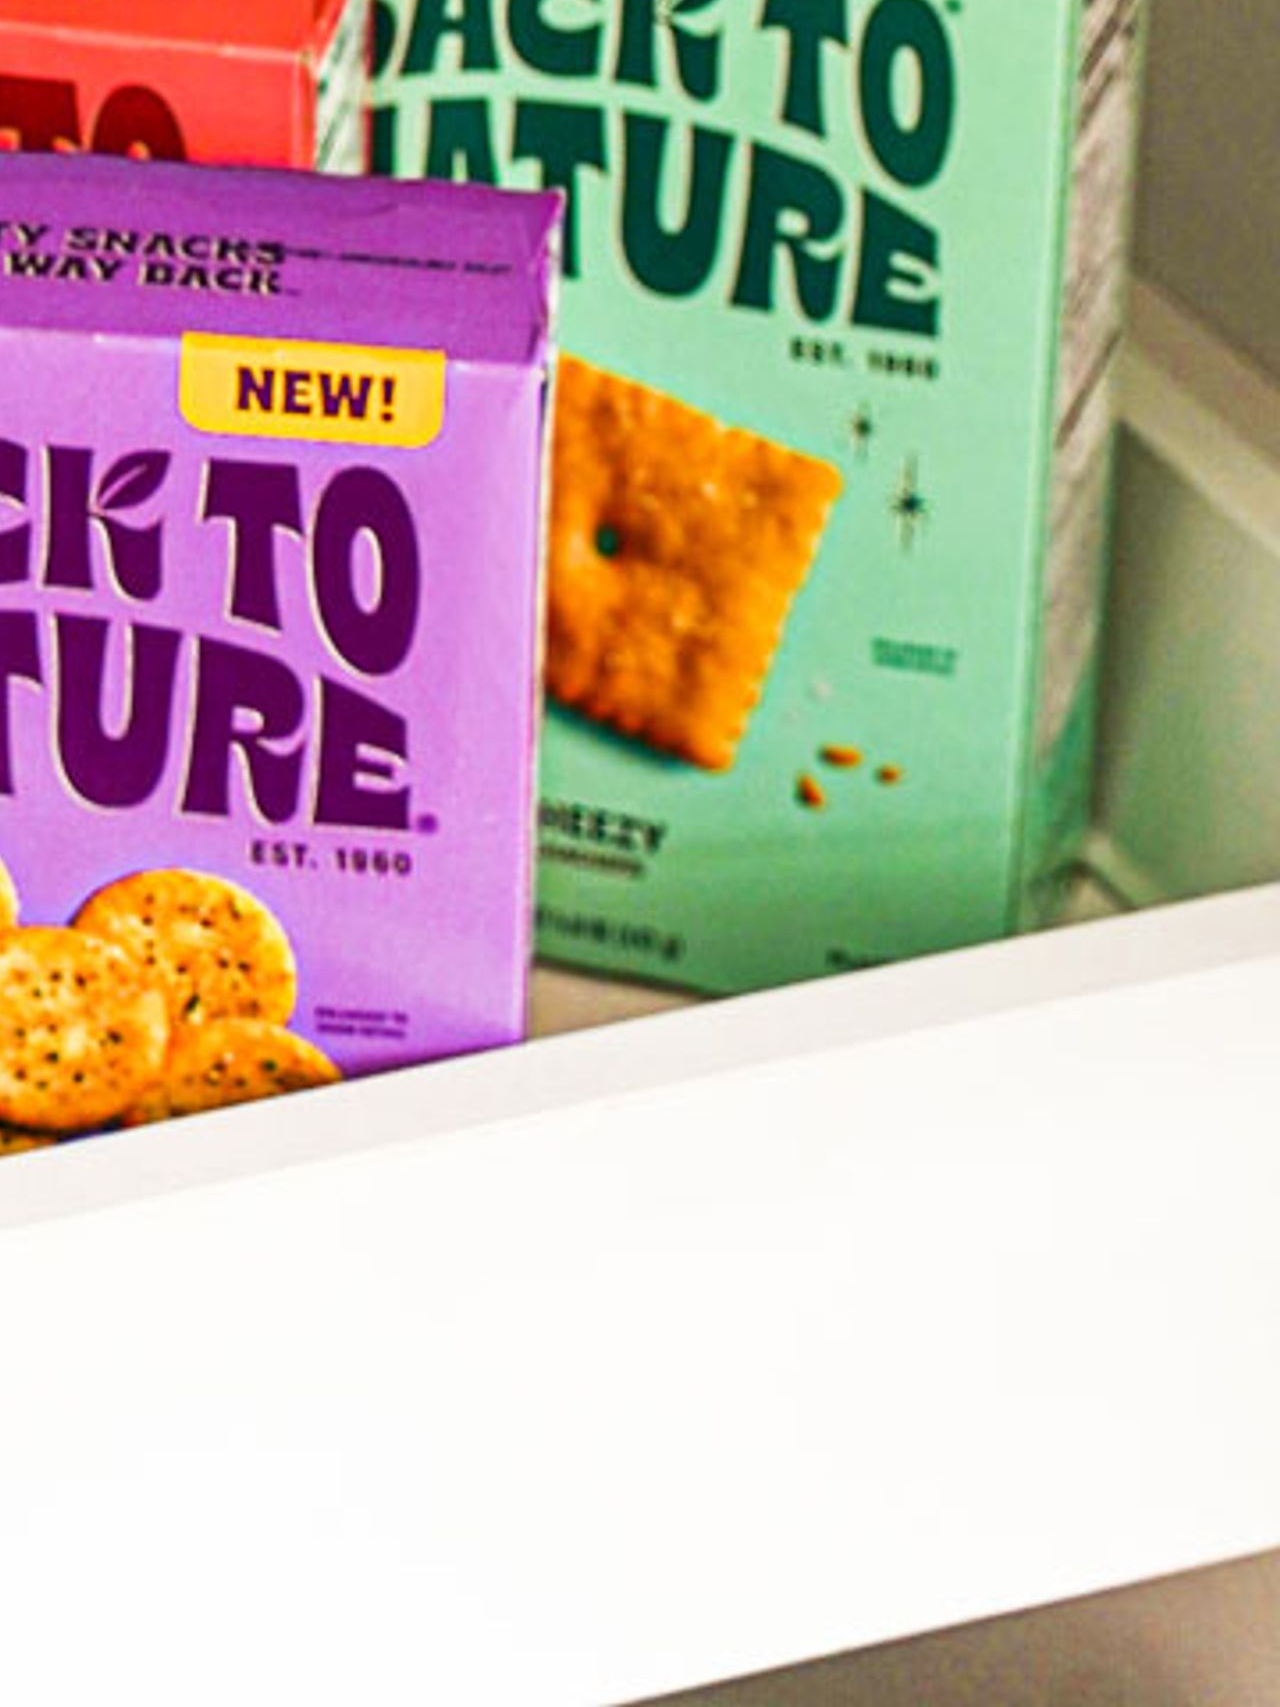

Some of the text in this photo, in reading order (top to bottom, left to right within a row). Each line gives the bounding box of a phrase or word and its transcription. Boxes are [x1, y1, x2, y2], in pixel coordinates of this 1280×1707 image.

[61, 228, 289, 265] SNACKS
[3, 252, 123, 283] WAY
[234, 365, 397, 422] NEW!
[201, 456, 420, 678] TO
[249, 843, 414, 876] EST. 1960
